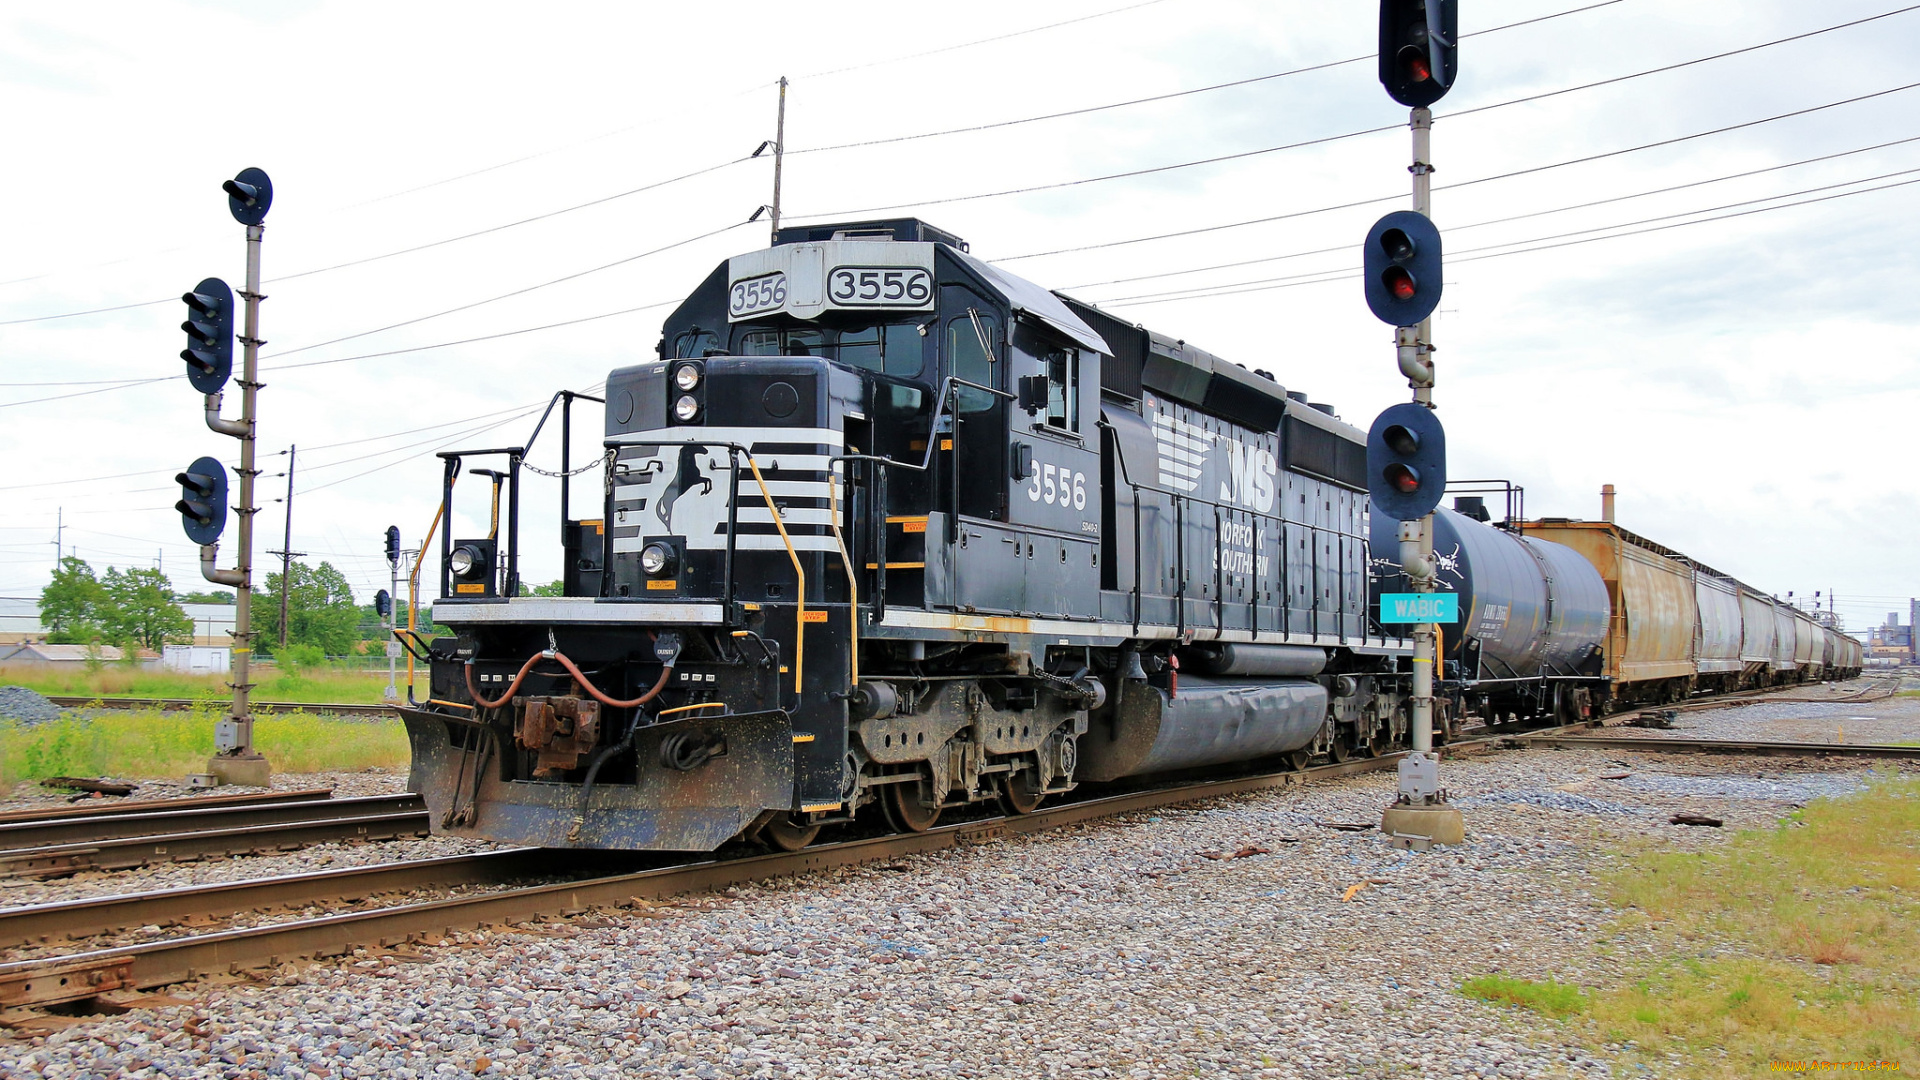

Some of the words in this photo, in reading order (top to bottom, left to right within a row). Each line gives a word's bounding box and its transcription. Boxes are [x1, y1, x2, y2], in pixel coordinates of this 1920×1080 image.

[733, 276, 787, 311] 3556
[834, 271, 929, 300] 3556
[1028, 459, 1087, 511] 3556
[1215, 520, 1264, 550] NORFOK
[867, 612, 874, 626] F
[1394, 599, 1444, 617] WABIC
